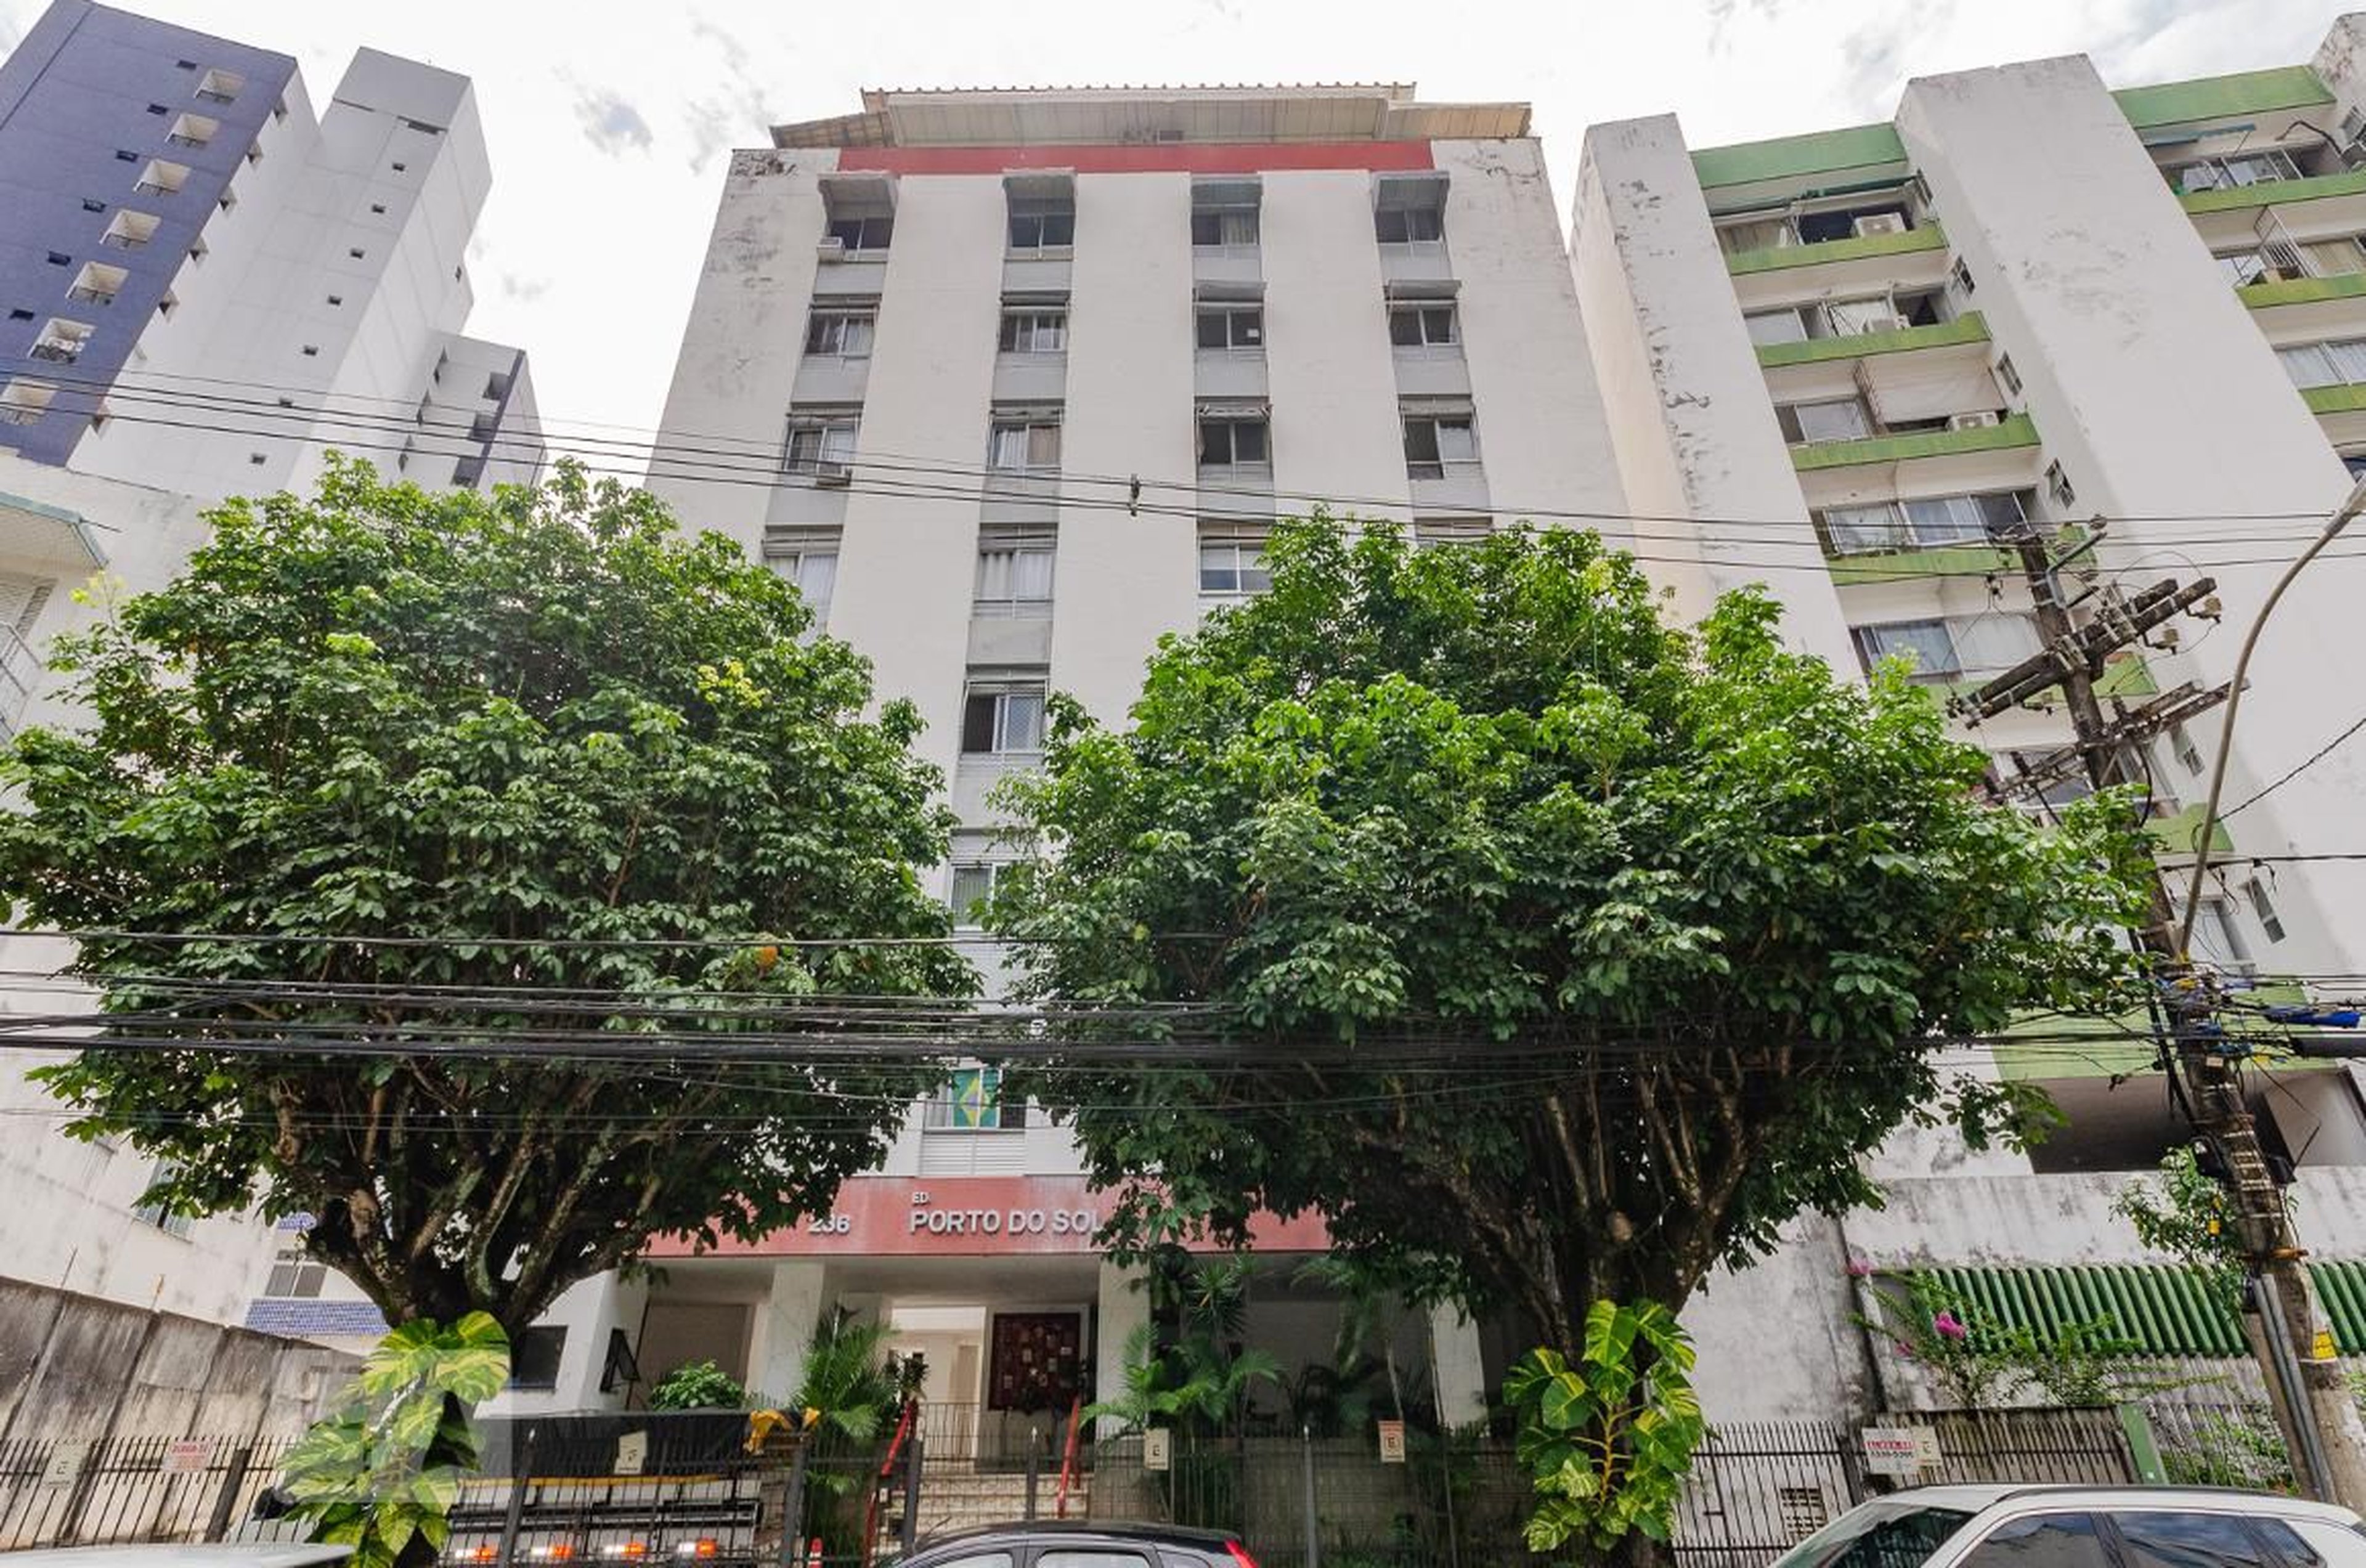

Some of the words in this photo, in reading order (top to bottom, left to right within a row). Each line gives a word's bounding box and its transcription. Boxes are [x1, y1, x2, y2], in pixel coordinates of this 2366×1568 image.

[910, 1209, 1002, 1234] PORTO
[1008, 1209, 1046, 1234] DO
[1052, 1209, 1104, 1234] SOL
